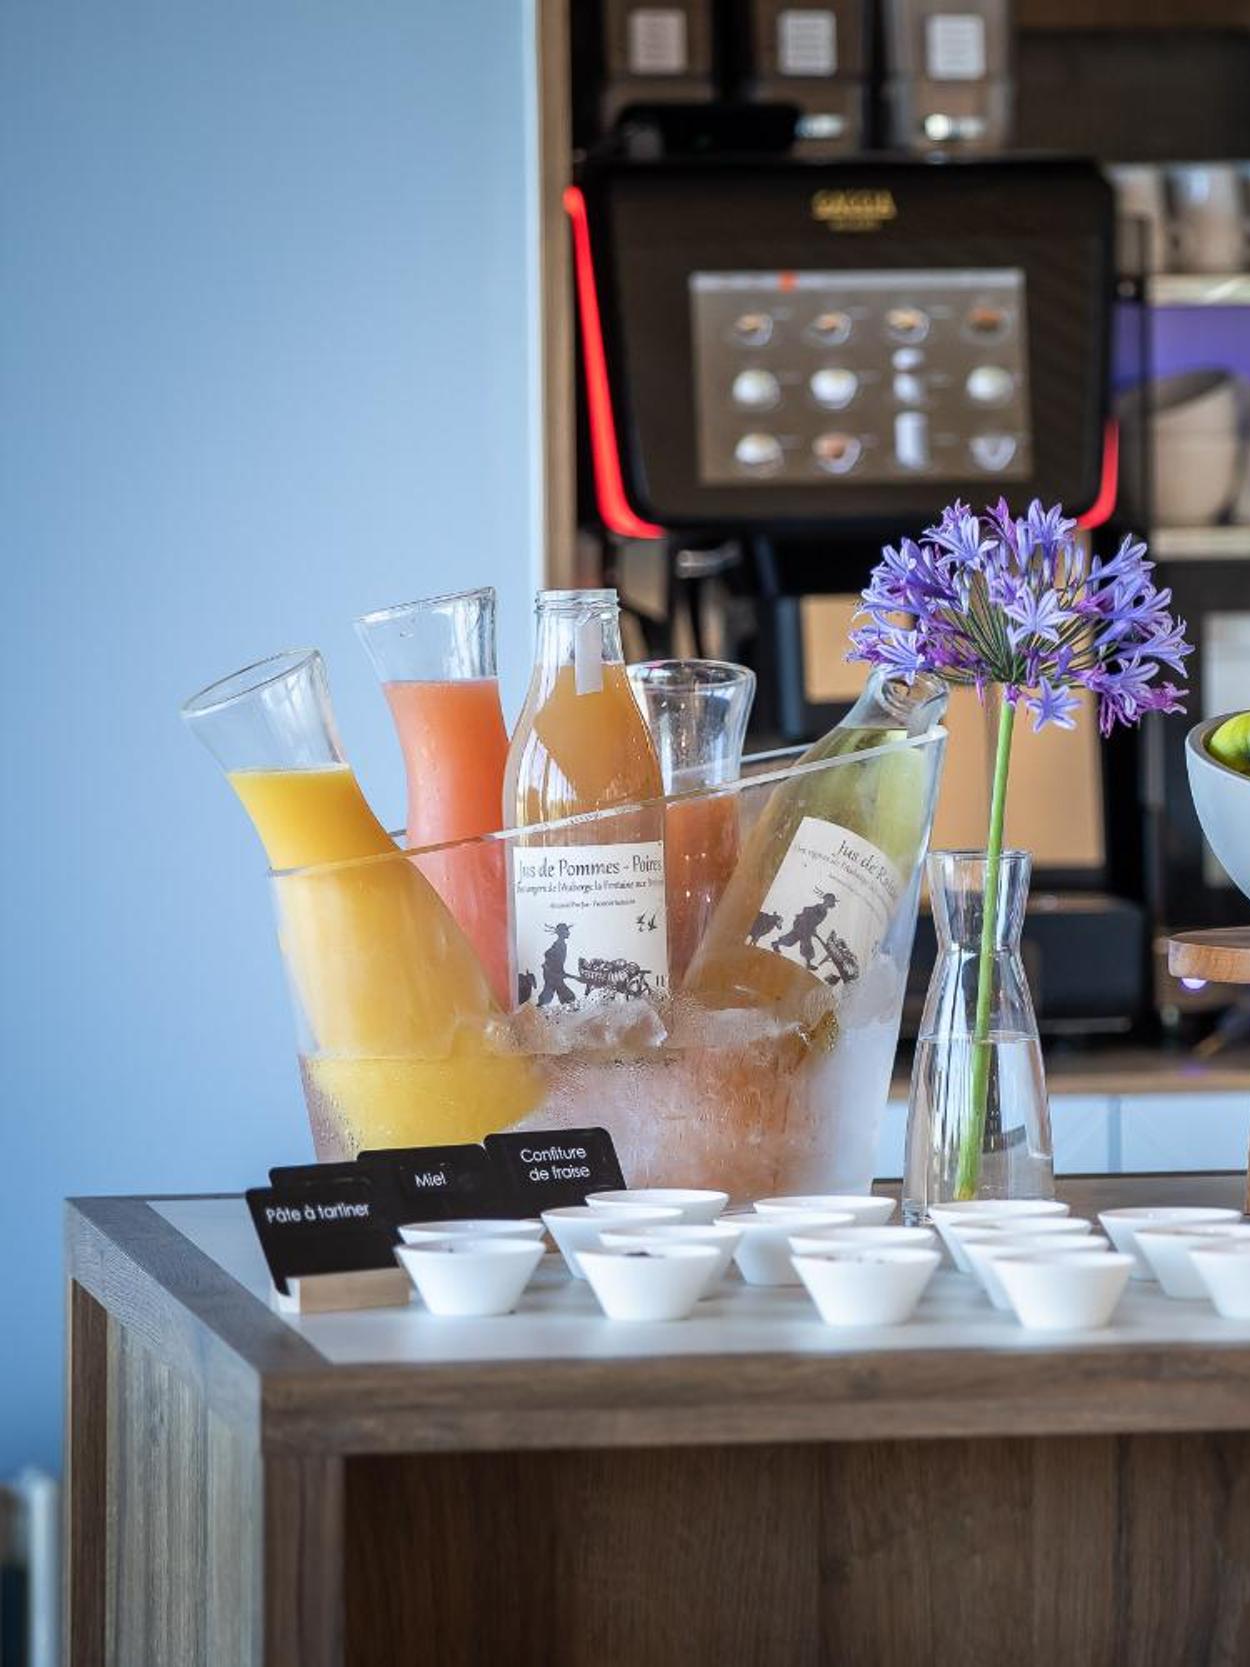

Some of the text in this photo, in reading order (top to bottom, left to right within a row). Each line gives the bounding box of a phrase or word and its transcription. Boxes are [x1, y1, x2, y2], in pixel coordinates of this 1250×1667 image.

[539, 857, 554, 877] de
[559, 858, 620, 877] Pommes
[632, 855, 662, 873] Poires
[832, 840, 860, 861] Jus
[860, 854, 877, 874] de
[520, 1146, 587, 1163] Confiture
[415, 1171, 448, 1188] Miel
[529, 1164, 591, 1181] de fraise
[266, 1202, 369, 1224] Pâte à tartiner
